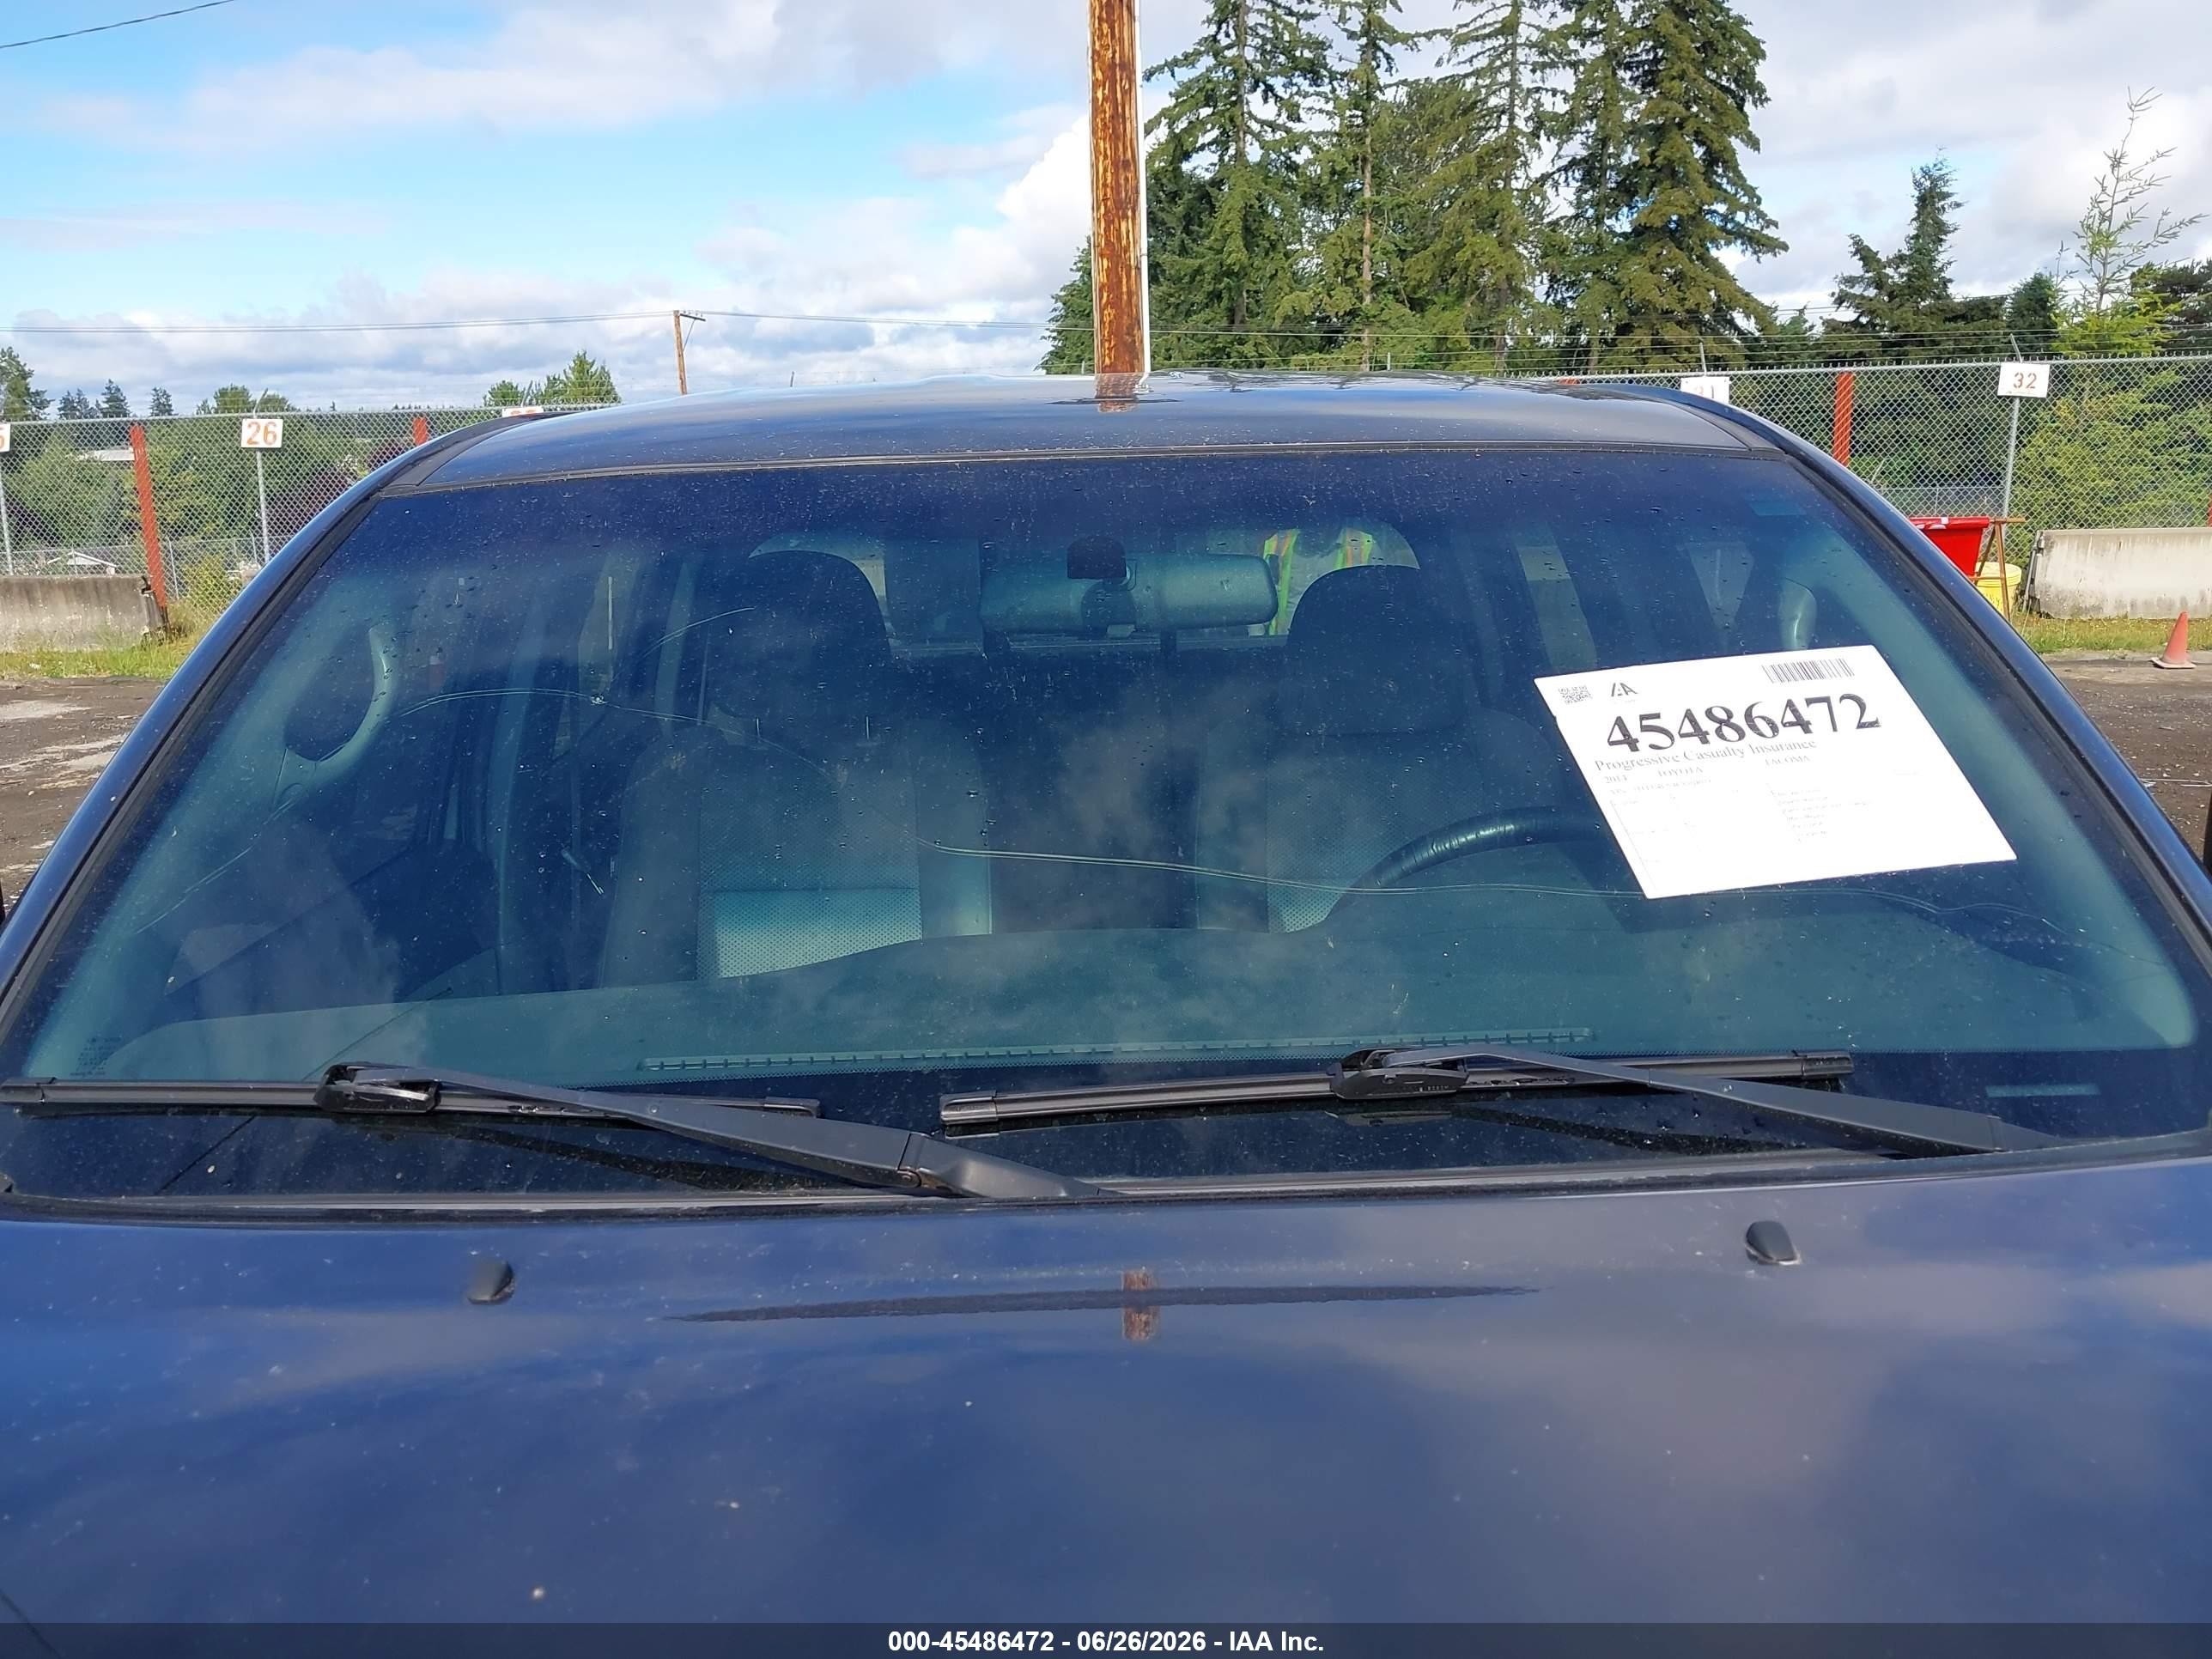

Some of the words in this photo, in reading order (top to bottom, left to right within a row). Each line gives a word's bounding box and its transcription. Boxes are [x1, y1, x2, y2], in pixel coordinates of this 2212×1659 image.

[2013, 372, 2038, 389] 32
[246, 421, 277, 446] 26
[1607, 693, 1882, 752] 45486472
[1595, 753, 1680, 772] Progressive
[1683, 744, 1746, 761] Casualty
[1748, 740, 1817, 756] Insurance
